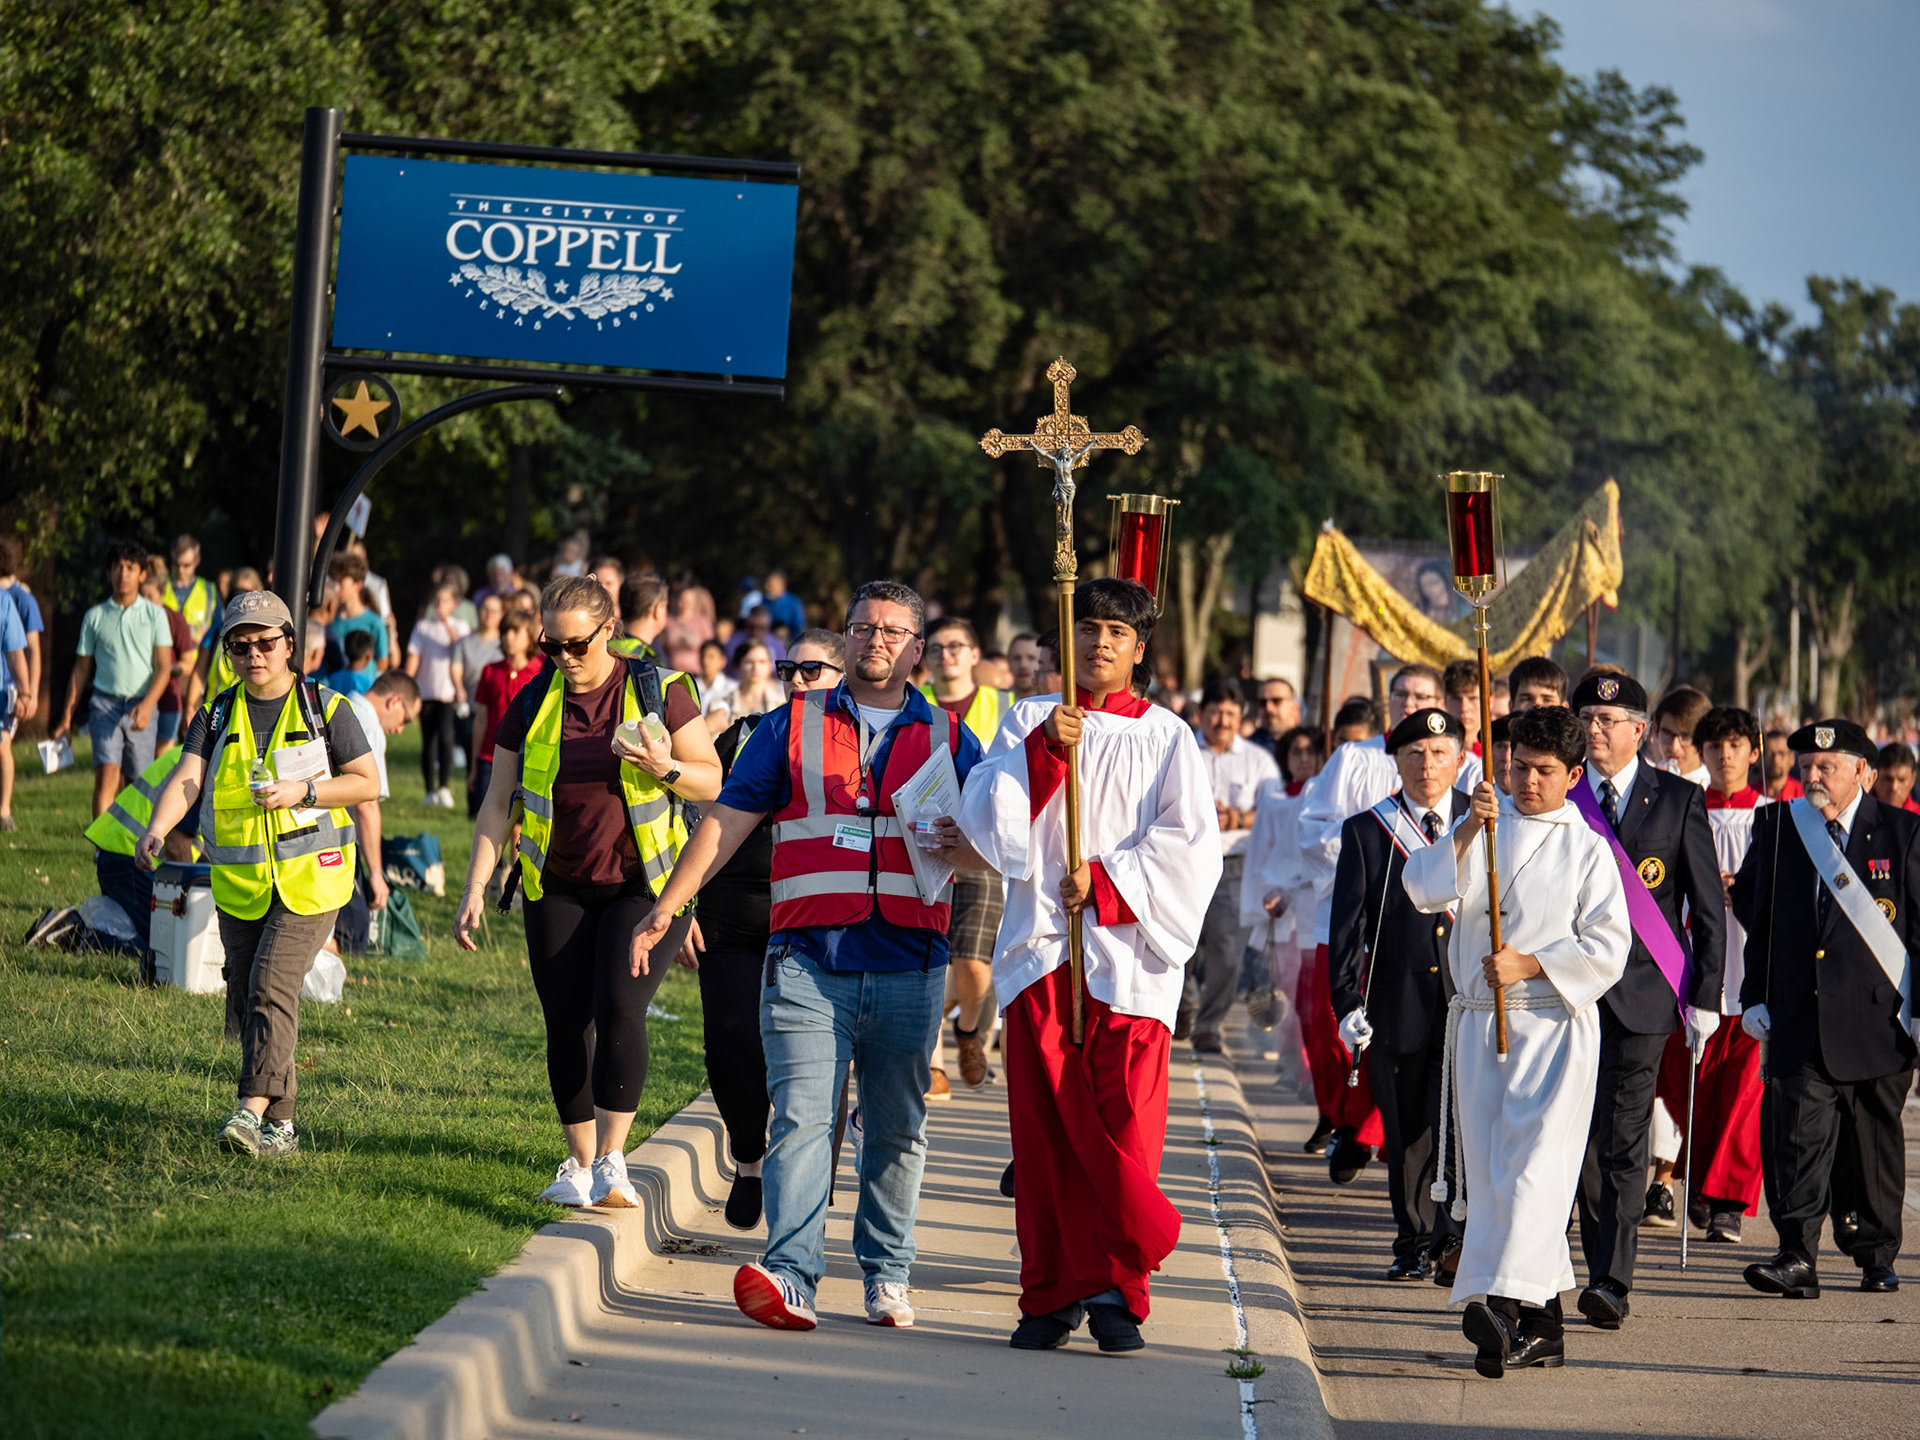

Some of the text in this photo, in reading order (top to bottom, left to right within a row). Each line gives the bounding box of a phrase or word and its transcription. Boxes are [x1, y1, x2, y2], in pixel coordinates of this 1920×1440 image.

[456, 199, 680, 225] THE CITY OF
[445, 218, 683, 275] COPPELL
[464, 288, 655, 332] TEXAS 1890
